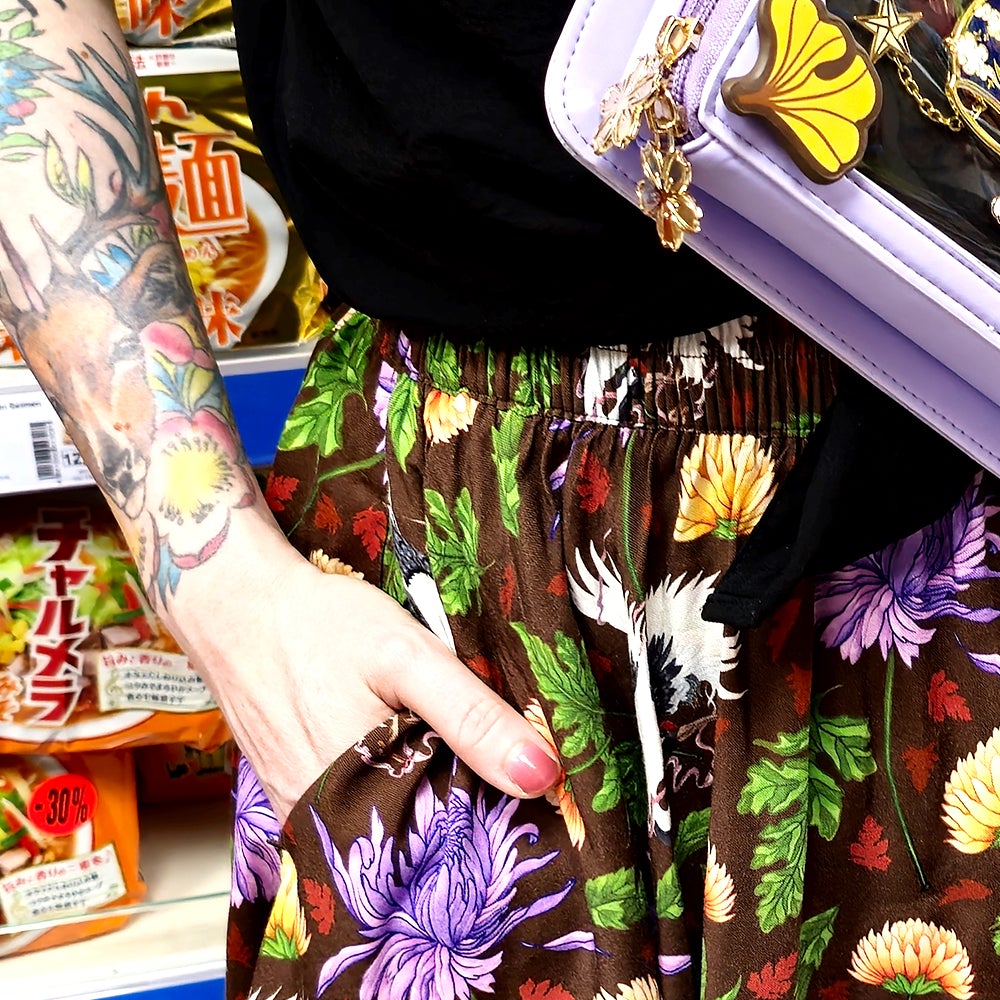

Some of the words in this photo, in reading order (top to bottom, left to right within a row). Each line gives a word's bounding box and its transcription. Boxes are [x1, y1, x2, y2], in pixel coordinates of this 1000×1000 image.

[33, 508, 95, 726] チャルメラ
[35, 786, 89, 825] -30%
